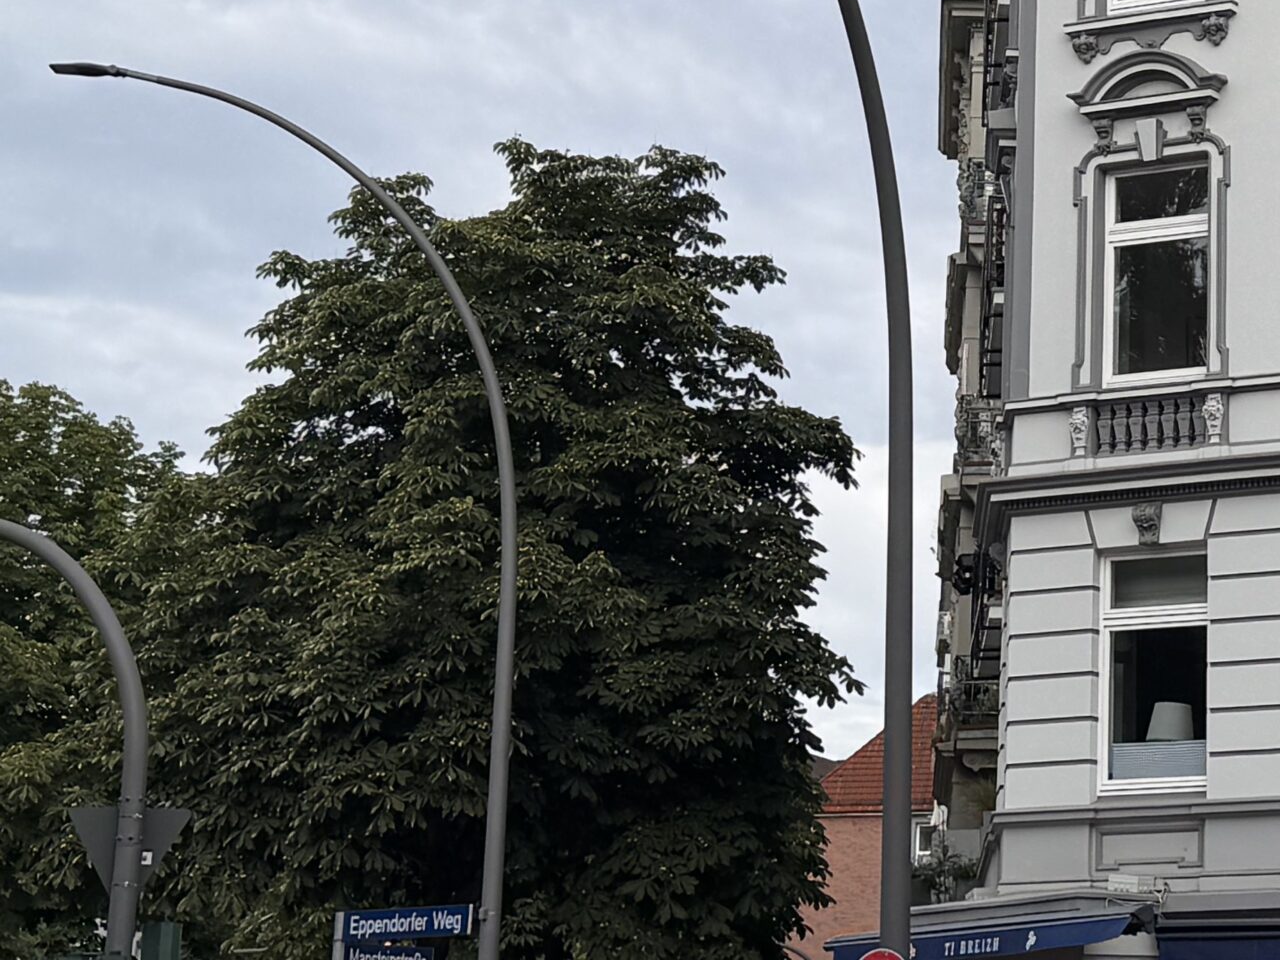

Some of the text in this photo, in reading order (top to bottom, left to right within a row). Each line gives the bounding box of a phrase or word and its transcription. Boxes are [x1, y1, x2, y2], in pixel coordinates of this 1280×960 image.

[350, 910, 461, 938] Eppendorfer Weg
[349, 947, 426, 960] Mansteinstß
